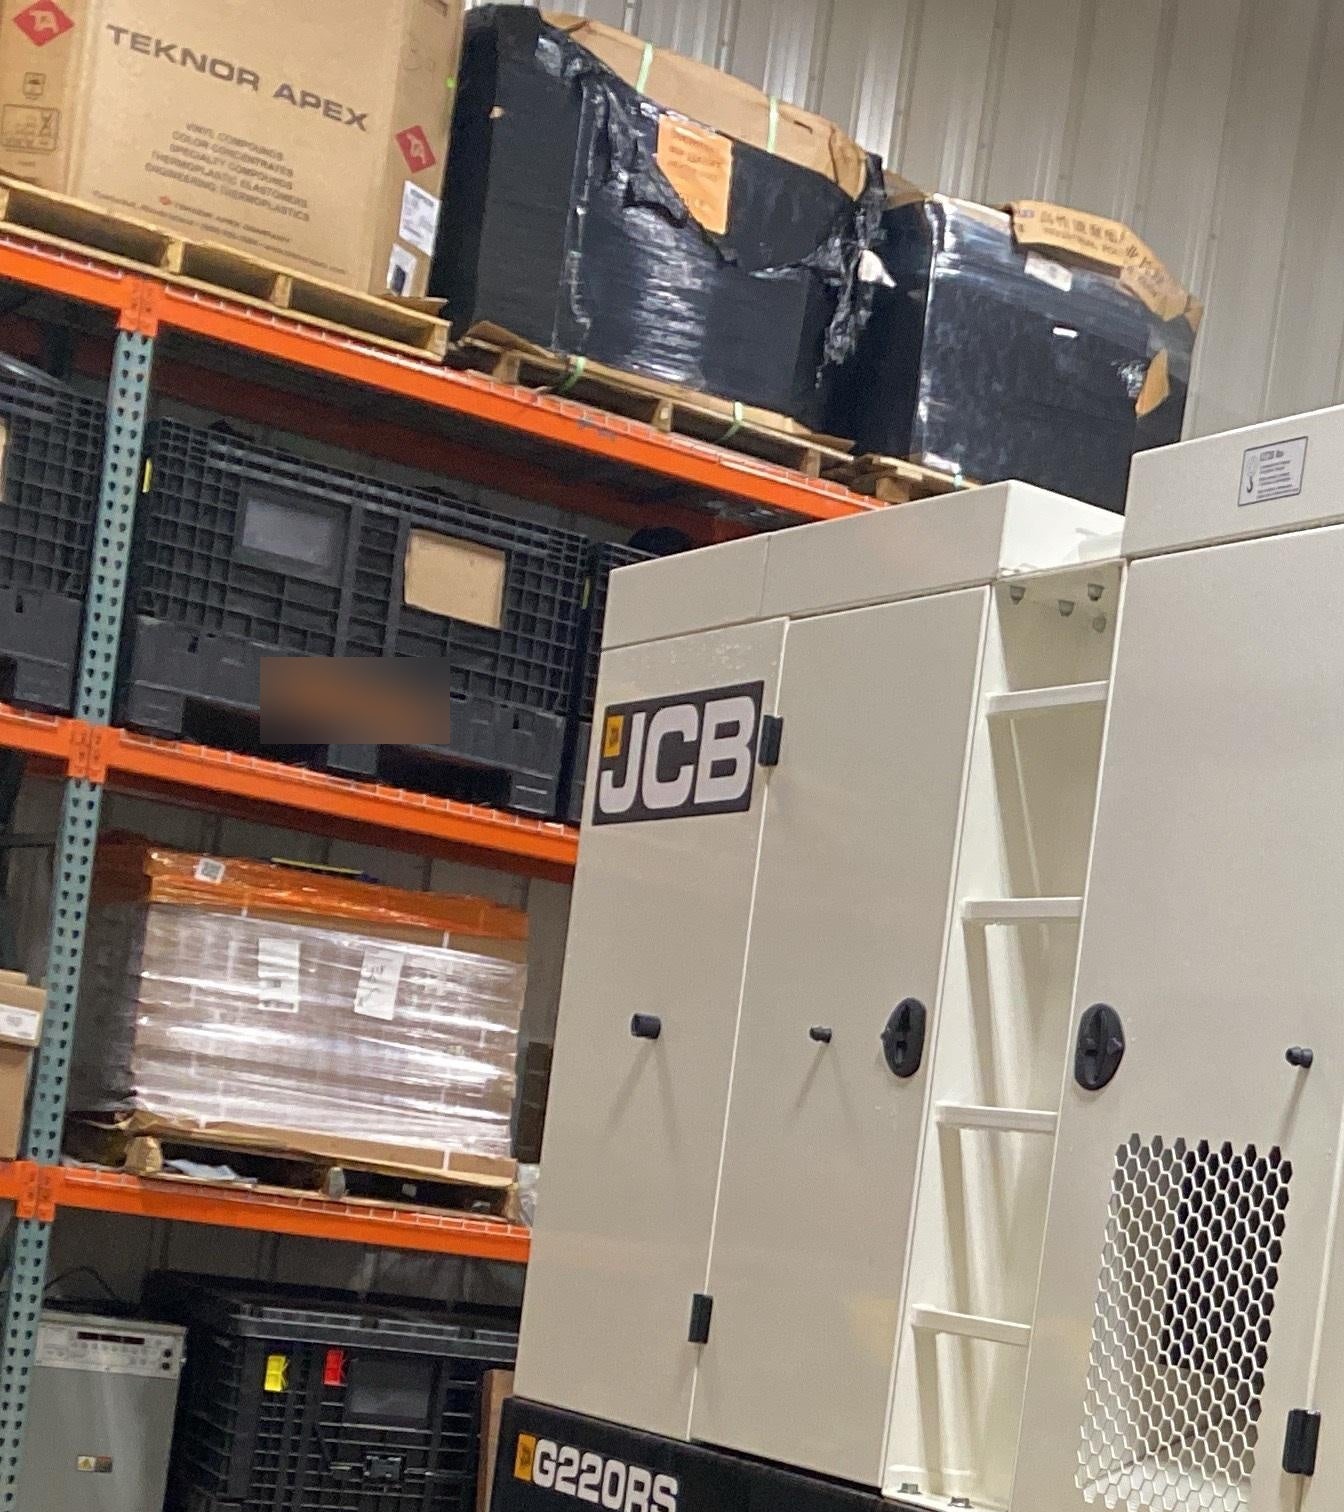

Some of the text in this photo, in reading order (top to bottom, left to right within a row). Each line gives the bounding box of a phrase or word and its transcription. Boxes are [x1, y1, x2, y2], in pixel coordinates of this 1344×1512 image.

[106, 24, 369, 132] TEKNOR APEX
[599, 696, 755, 814] JCB
